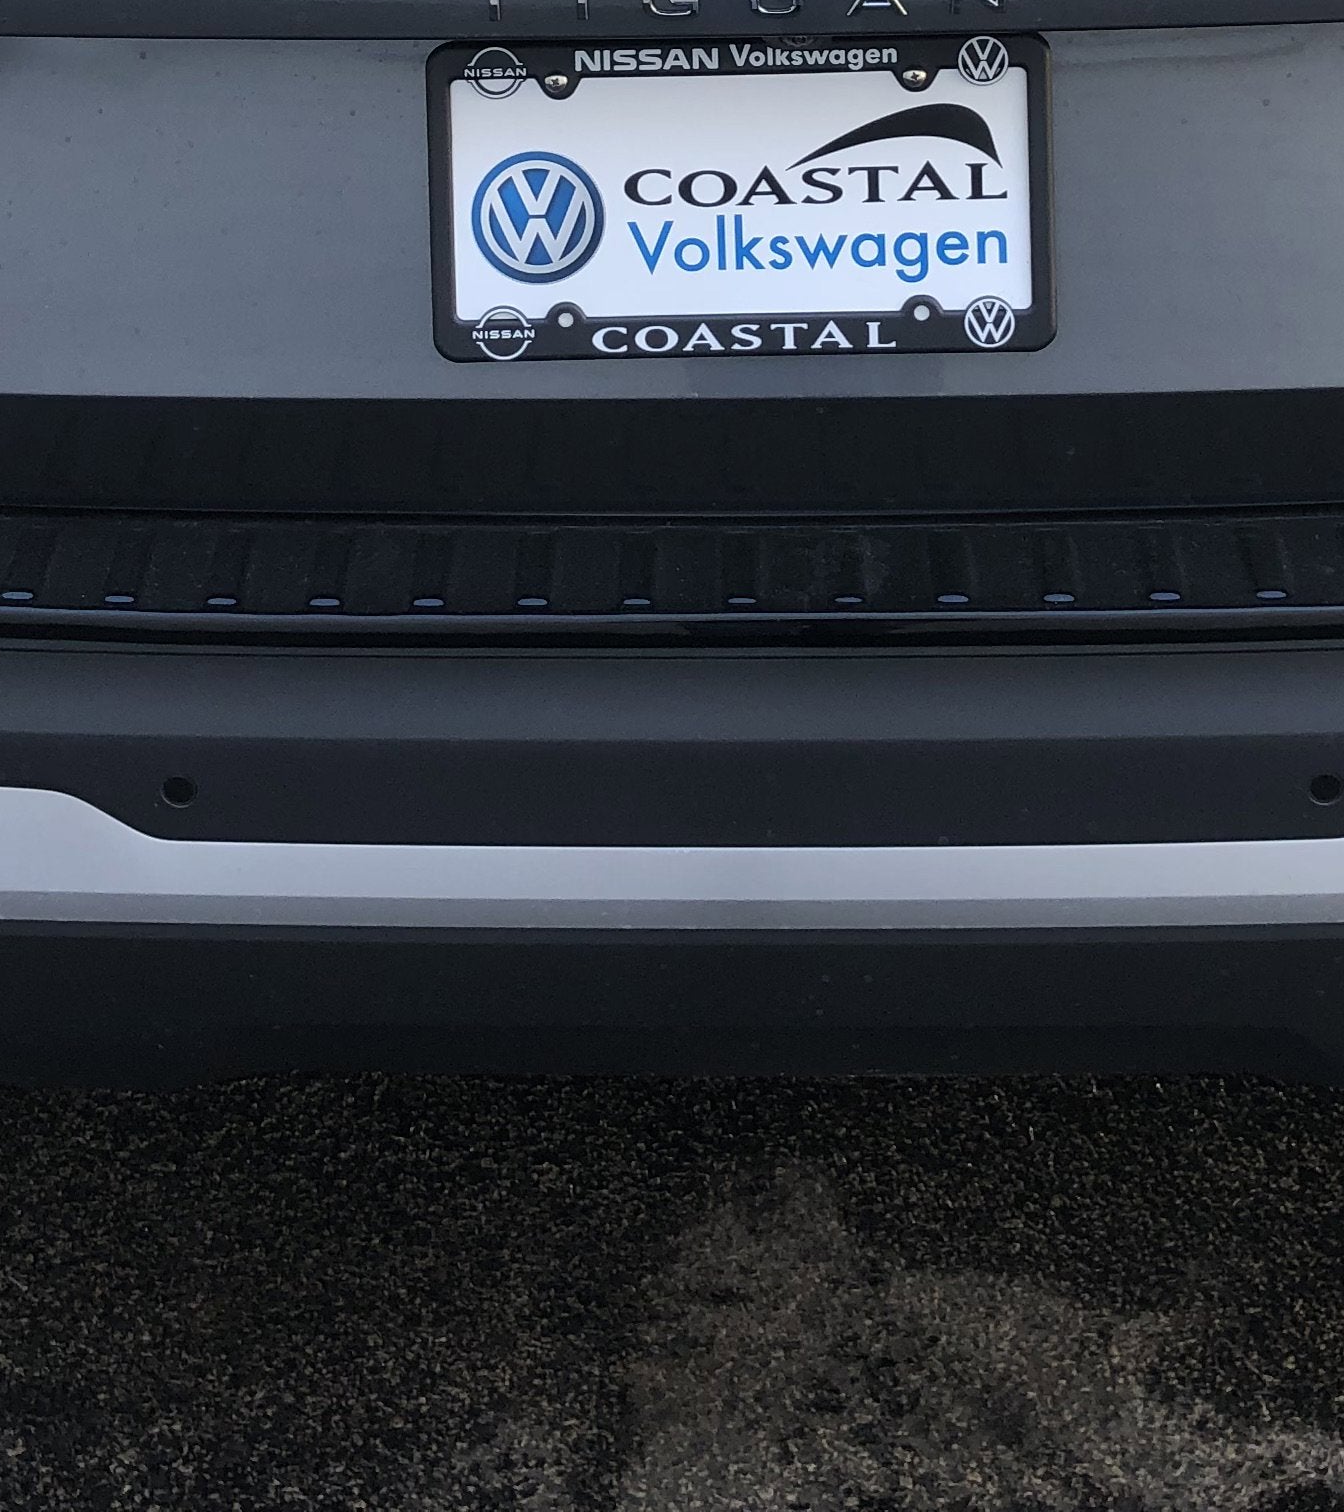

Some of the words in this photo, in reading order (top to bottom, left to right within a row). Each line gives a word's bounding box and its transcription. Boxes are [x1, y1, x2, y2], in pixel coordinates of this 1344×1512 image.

[464, 65, 528, 80] NISSAN
[574, 47, 719, 72] NISSAN
[729, 43, 898, 70] Volkswagen
[623, 160, 1008, 207] COASTAL
[627, 214, 1008, 283] Volkswagen
[471, 327, 535, 342] NISSAN
[590, 321, 897, 354] COASTAL
